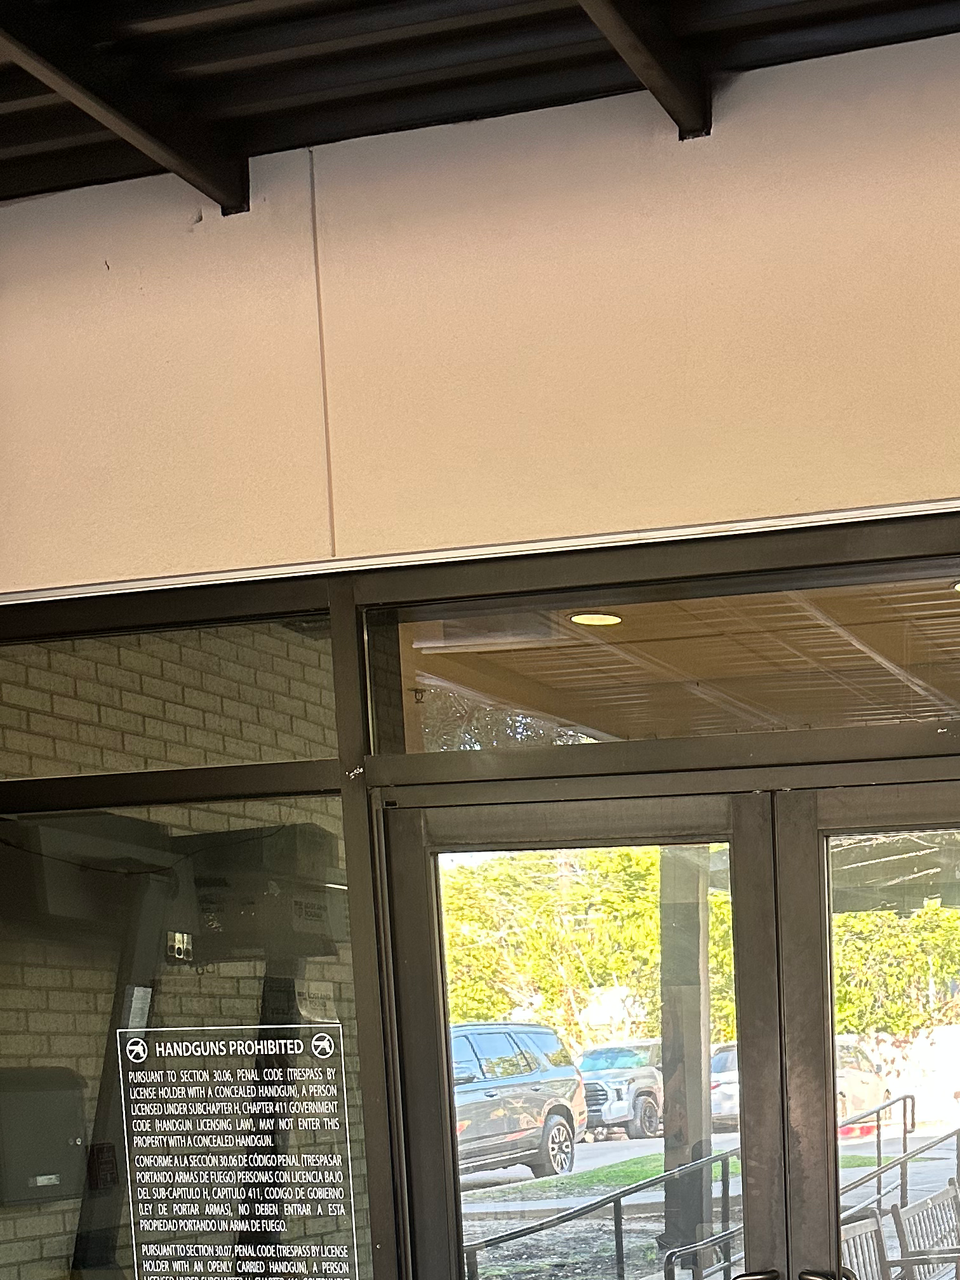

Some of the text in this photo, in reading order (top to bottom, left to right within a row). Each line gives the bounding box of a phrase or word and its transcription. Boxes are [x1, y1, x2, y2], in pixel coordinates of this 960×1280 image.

[155, 1039, 303, 1056] HANDGUNS PROHIBITED
[128, 1067, 335, 1082] PURSUANT TO SECTION 30.06, PENAL CODE (TRESPASS BY
[129, 1084, 336, 1099] LICENSE HOLDER WITH A CONCEALED HANDGUN), A PERSON
[130, 1100, 338, 1115] LICENSED UNDER SUBCHAPTER H, CHAPTER 411 GOVERNMENT
[131, 1117, 339, 1132] CODE (HANDGUN LICENSING LAW), MAY NOT ENTER THIS
[134, 1155, 172, 1167] CONFORME
[173, 1155, 178, 1167] A
[179, 1155, 188, 1167] LA
[219, 1155, 237, 1166] 30.06
[238, 1155, 248, 1166] DE
[277, 1154, 299, 1166] PENAL
[301, 1154, 342, 1166] (TRESPASAR
[135, 1170, 342, 1183] PORTANDO ARMAS DE FUEGO) PERSONAS CON LICENCIA BAJO
[137, 1187, 344, 1199] DEL SUB-CAPITULO H, CAPITULO 411, CODIGO DE GOBIERNO
[138, 1203, 345, 1216] (LEY DE PORTAR ARMAS), NO DEBEN ENTRAR A ESTA
[139, 1220, 286, 1231] PROPIEDAD PORTANDO UN ARMA DE FUEGO.
[142, 1260, 348, 1273] HOLDER WITH AN OPENLY CARRIED HANDGUN), A PERSON
